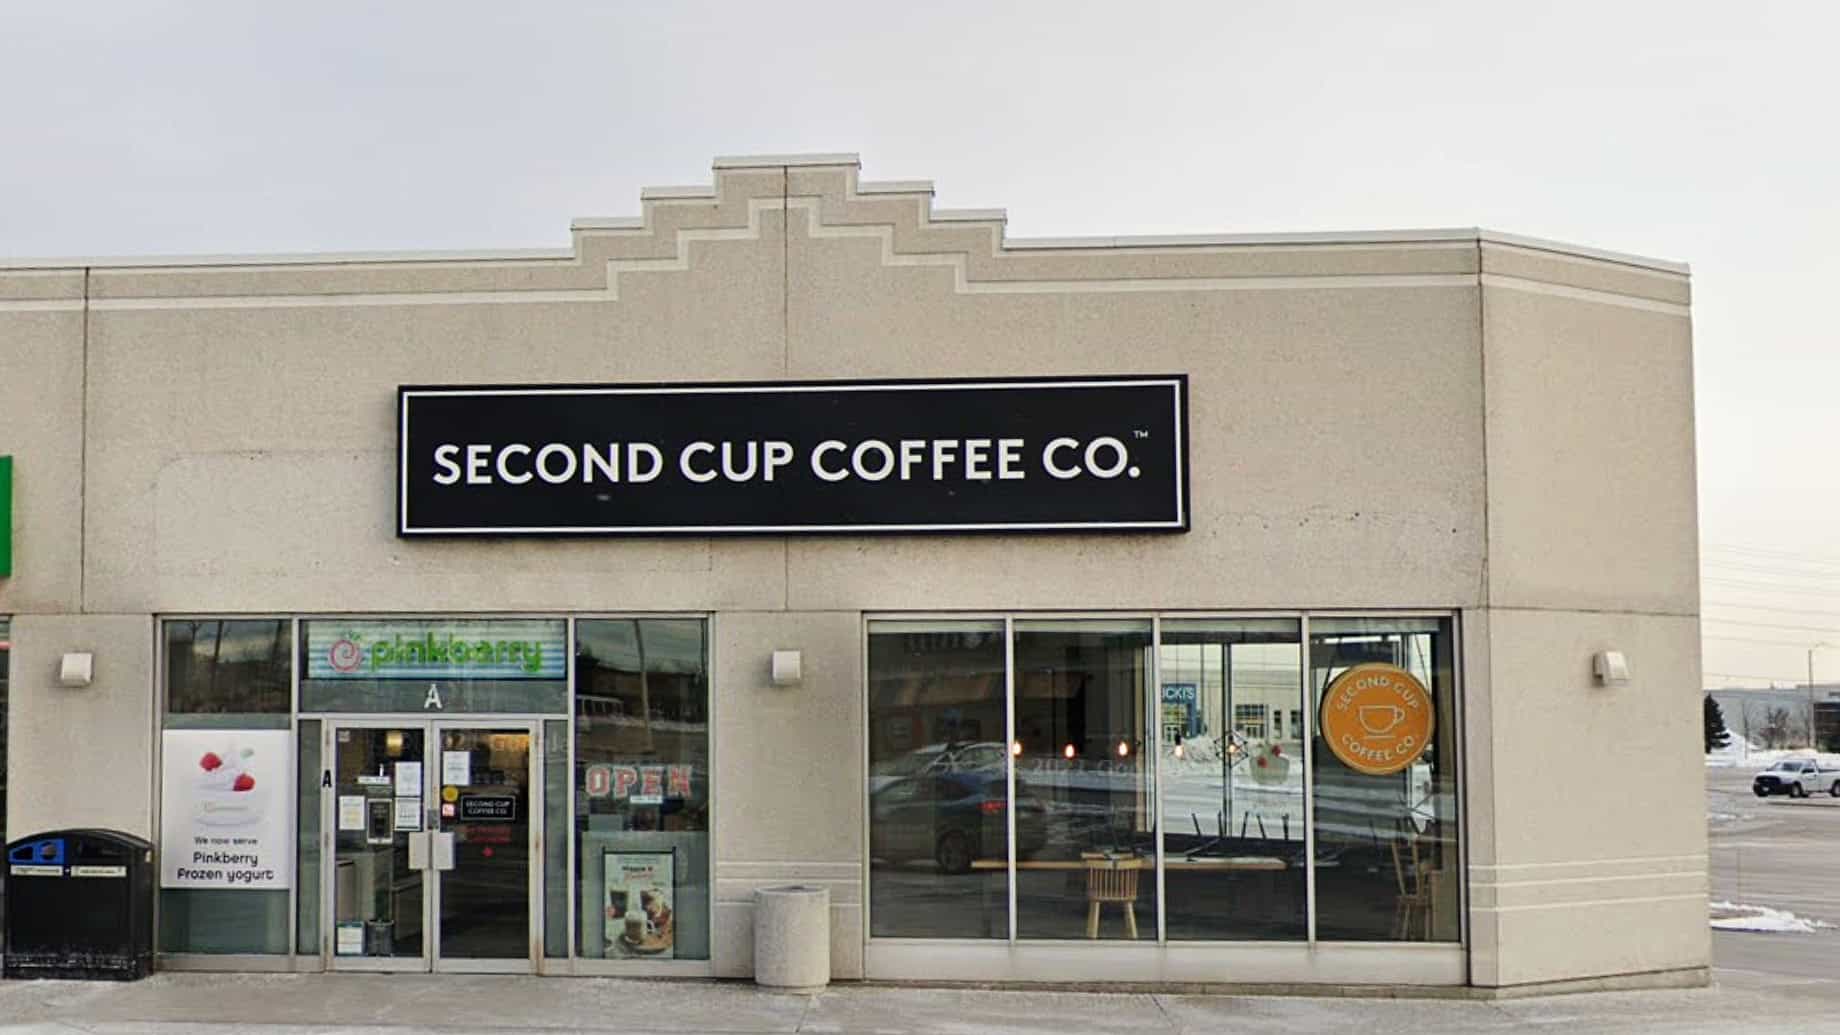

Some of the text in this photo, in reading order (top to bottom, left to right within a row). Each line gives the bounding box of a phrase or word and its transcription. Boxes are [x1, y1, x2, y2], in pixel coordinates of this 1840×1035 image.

[432, 436, 1141, 485] SECOND CUP COFFEE CO.
[423, 682, 443, 709] A
[1336, 677, 1418, 711] SECOND CUP
[322, 769, 332, 788] A
[585, 764, 693, 799] OPEN
[192, 851, 258, 867] Pinkberry
[226, 869, 274, 884] yogurt
